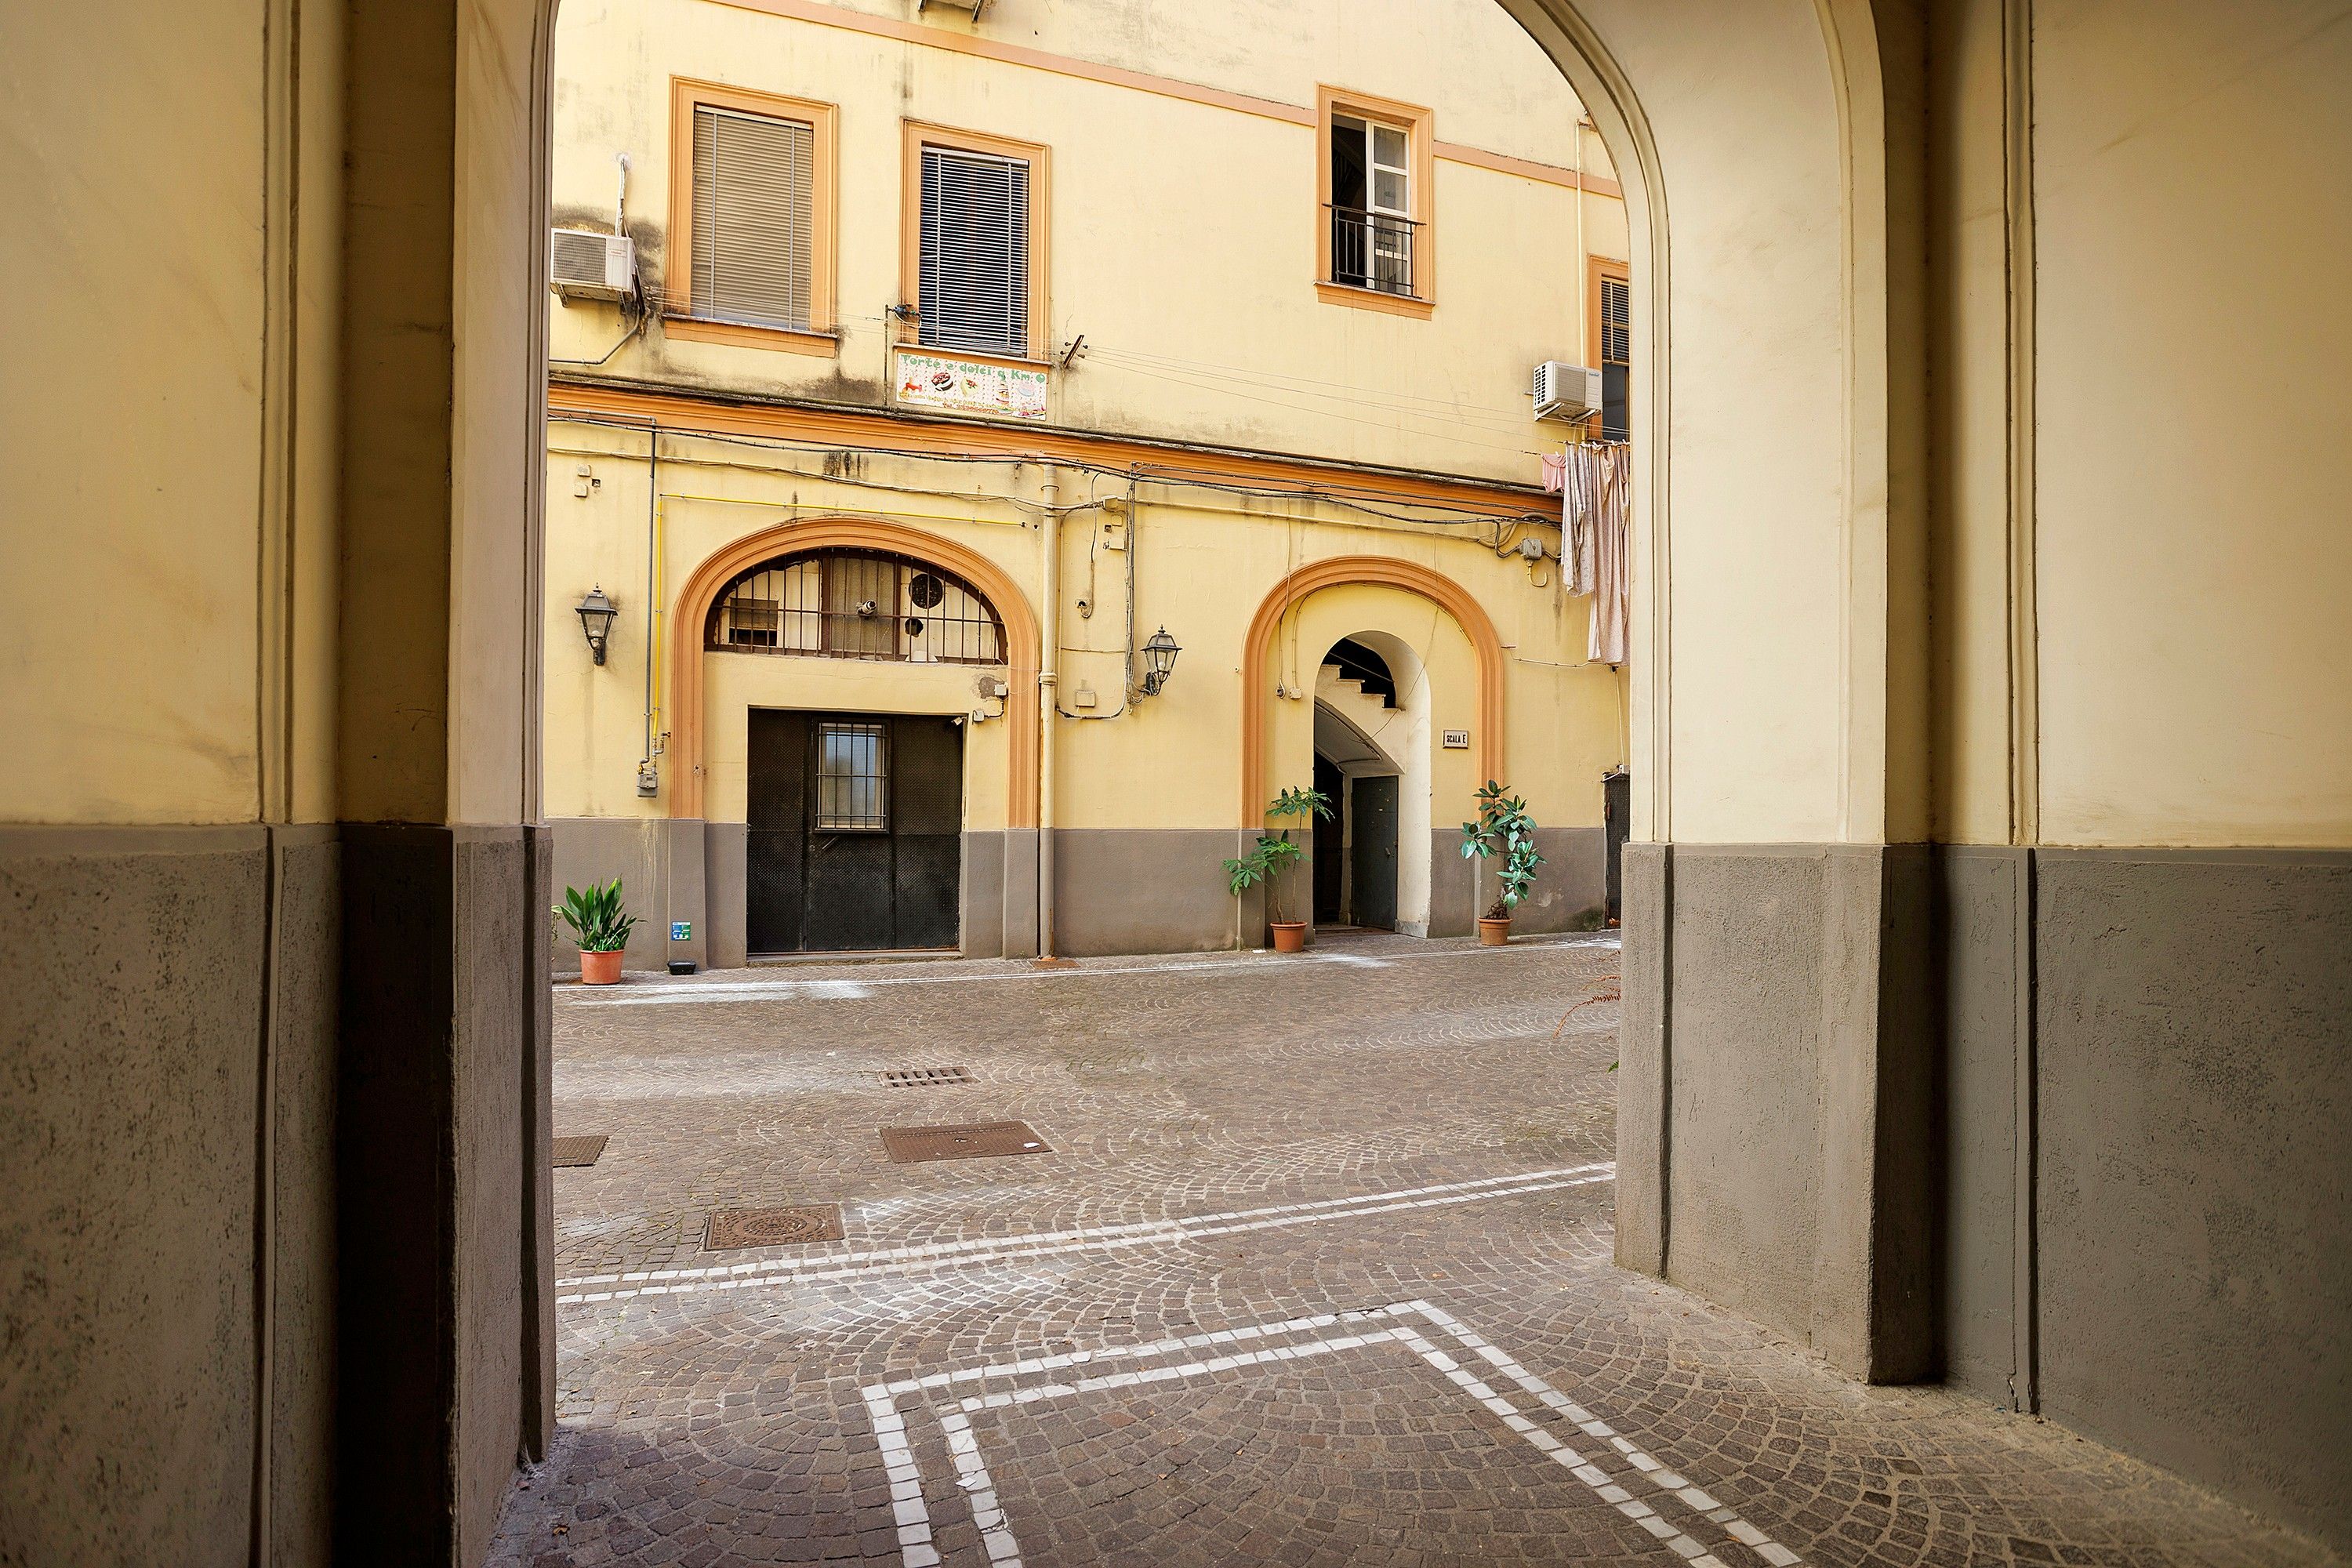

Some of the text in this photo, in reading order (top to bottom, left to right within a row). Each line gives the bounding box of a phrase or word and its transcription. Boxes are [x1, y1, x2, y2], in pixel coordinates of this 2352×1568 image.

[901, 354, 941, 368] Torte
[960, 363, 992, 376] dolci
[1011, 370, 1030, 381] Km
[1446, 734, 1466, 743] SCALA E
